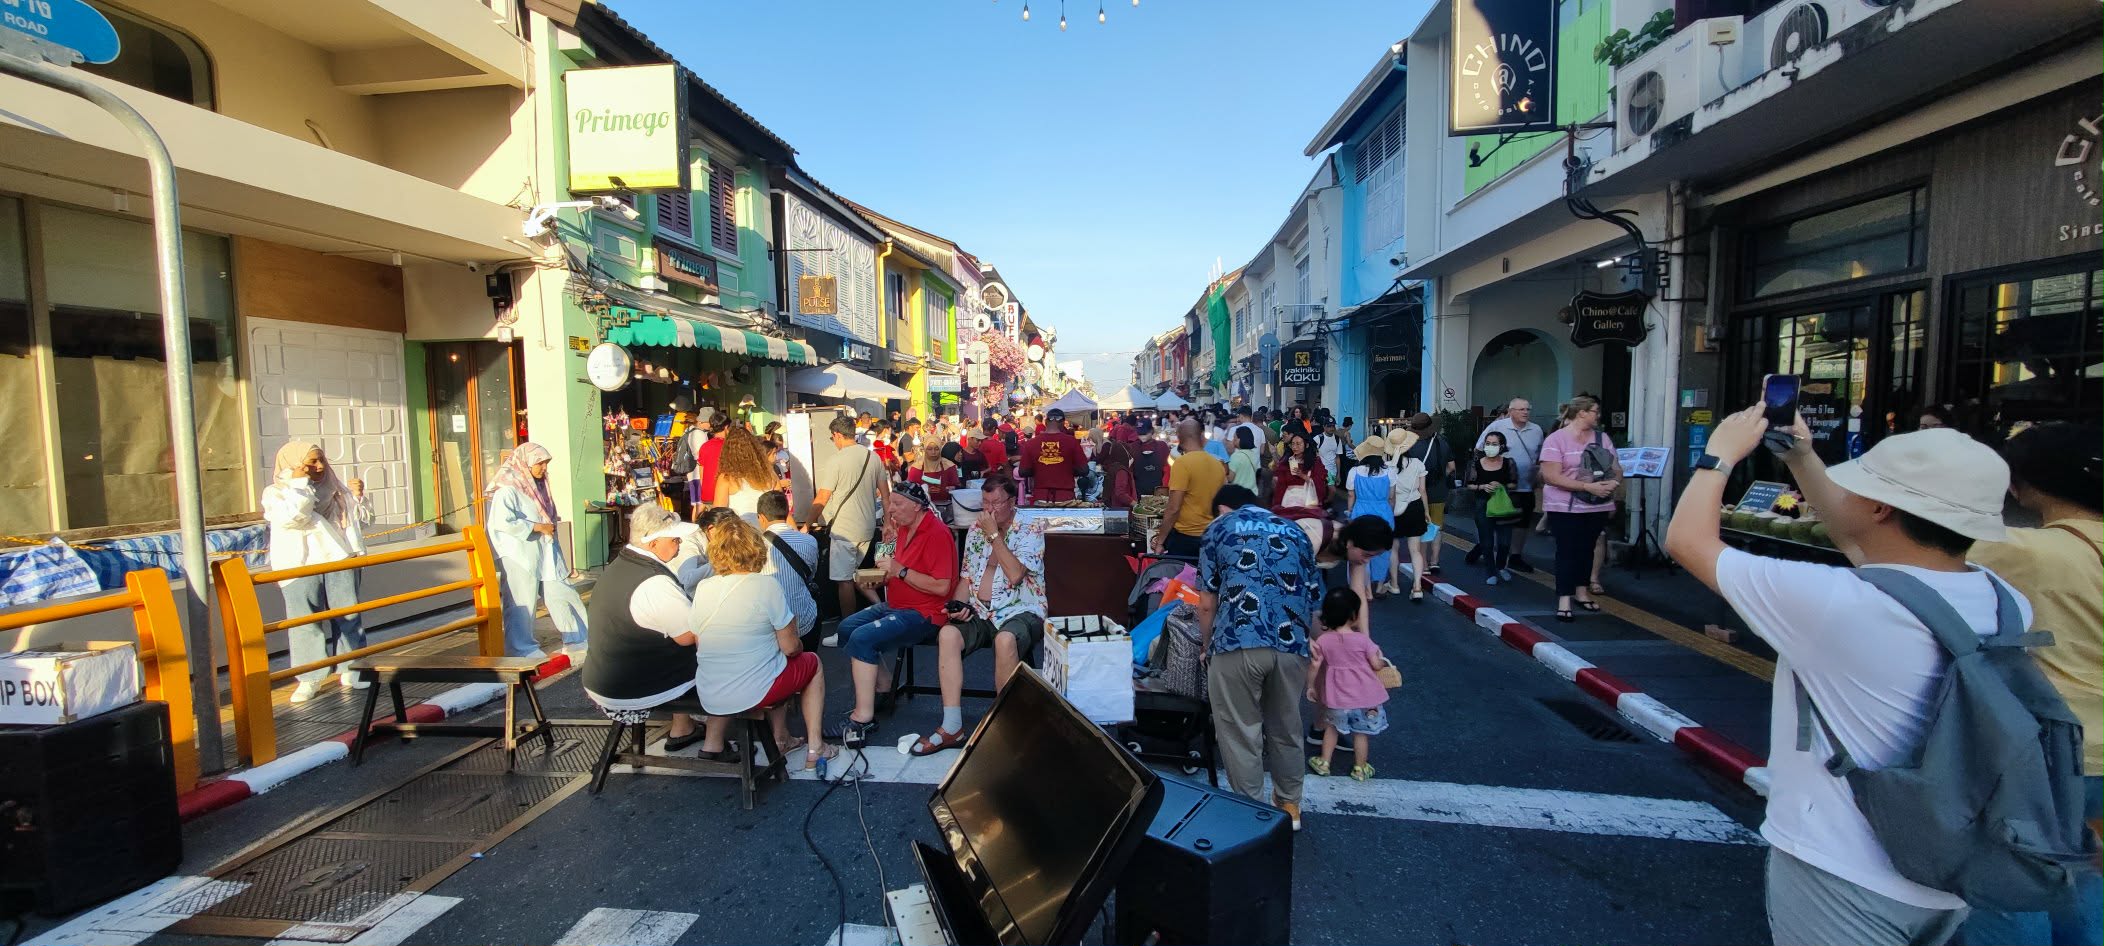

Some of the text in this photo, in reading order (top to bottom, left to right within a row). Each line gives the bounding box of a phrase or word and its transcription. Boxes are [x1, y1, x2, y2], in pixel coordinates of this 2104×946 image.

[4, 12, 48, 35] ROAD
[1462, 33, 1546, 75] CHINO
[575, 108, 669, 136] Primego
[668, 249, 711, 280] Primego
[803, 297, 831, 308] PULSE
[1593, 320, 1624, 331] Gallery
[1284, 366, 1321, 375] yakiniku
[1284, 373, 1321, 382] KOKU
[20, 680, 59, 707] BOX
